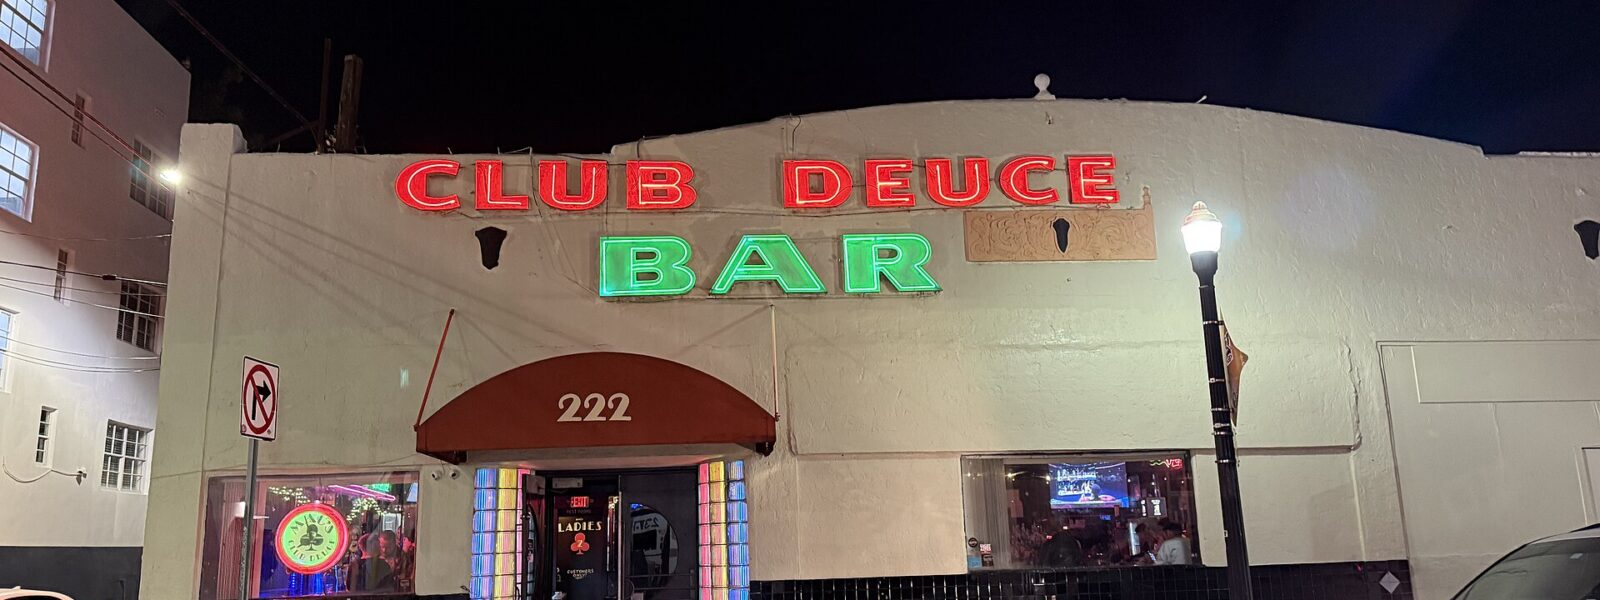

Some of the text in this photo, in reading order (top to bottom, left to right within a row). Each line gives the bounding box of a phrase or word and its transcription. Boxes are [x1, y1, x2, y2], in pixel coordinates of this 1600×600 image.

[395, 154, 1121, 212] CLUB DEUCE
[599, 234, 942, 298] BAR
[556, 393, 632, 422] 222
[557, 520, 603, 533] LADIES
